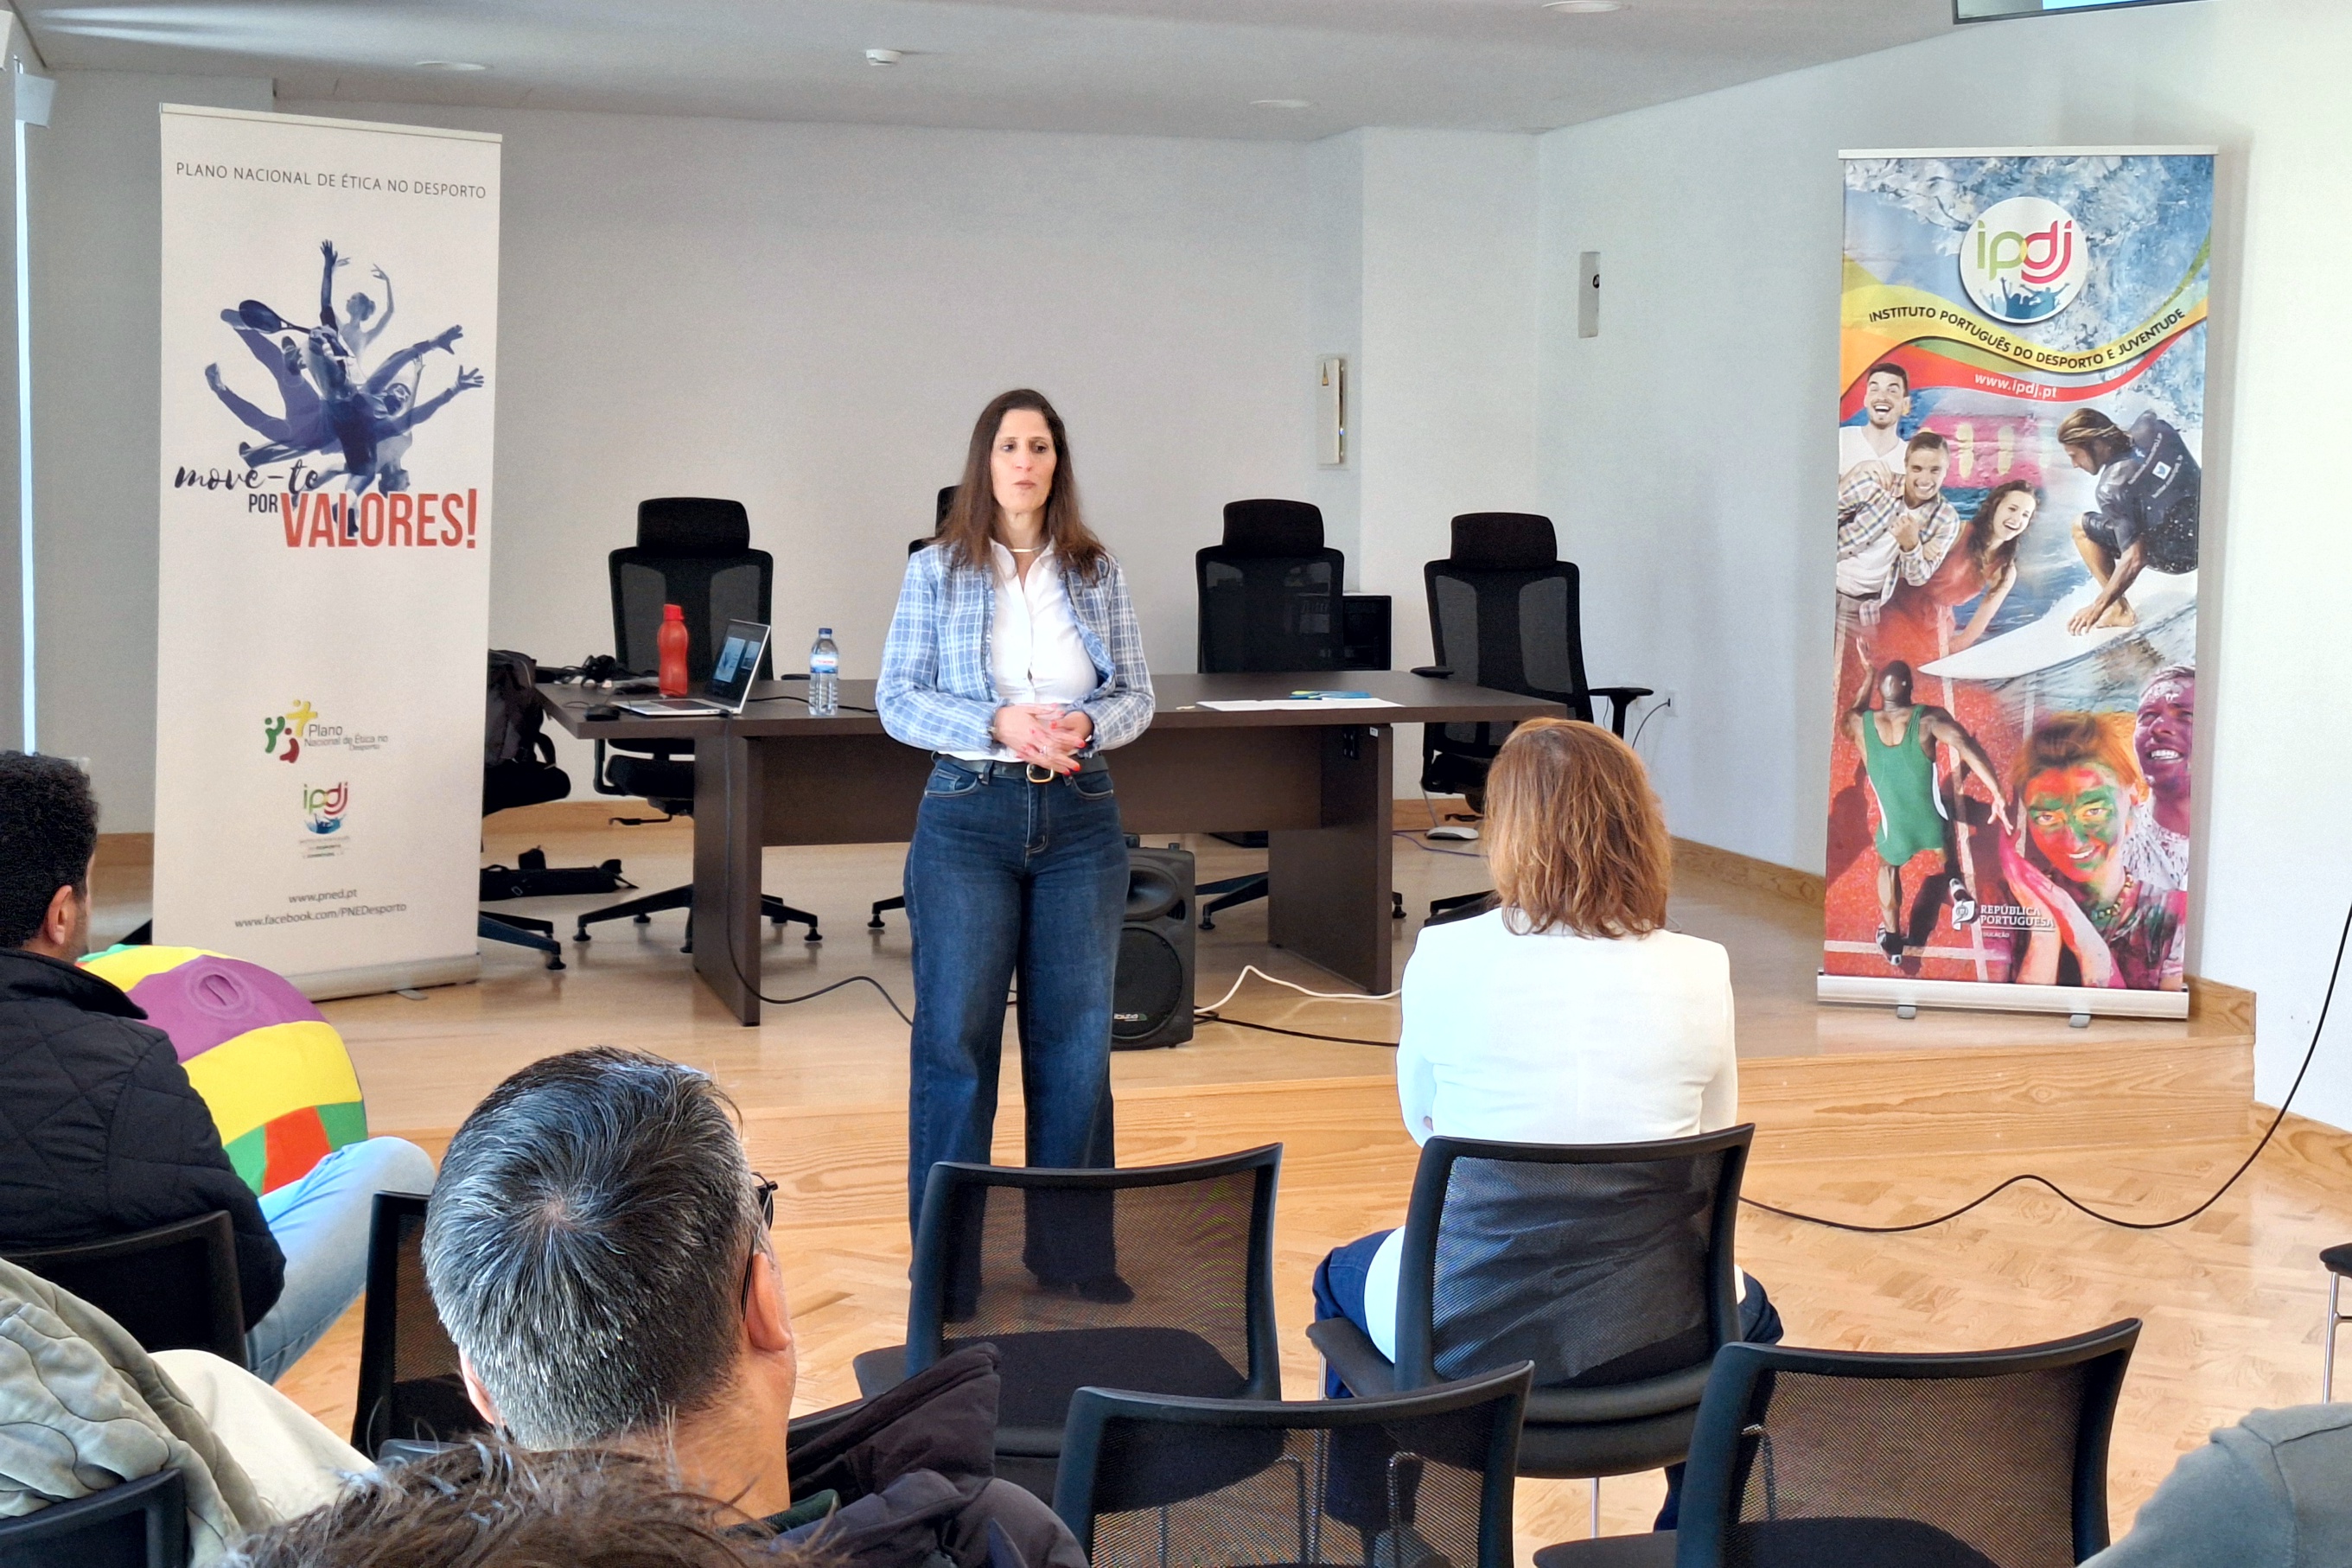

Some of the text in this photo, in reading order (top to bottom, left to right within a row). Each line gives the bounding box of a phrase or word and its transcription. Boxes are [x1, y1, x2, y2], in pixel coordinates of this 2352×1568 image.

[176, 162, 487, 199] PLANO NACIONAL DE ÉTICA NO DESPORTO
[1976, 220, 2073, 284] ipdj
[1869, 306, 2185, 369] INSTITUTO PORTUGUÊS DO DESPORTO E JUVENTUDE
[1974, 373, 2058, 399] www.ipdj.pt
[174, 458, 320, 494] move-te
[248, 488, 478, 549] POR VALORES!
[309, 723, 343, 737] Plano
[303, 781, 348, 815] ipdj
[288, 889, 357, 903] www.pned.pt
[1980, 903, 2041, 916] REPÚBLICA
[234, 902, 407, 927] www.facebook.com/PNEDesporto
[1980, 915, 2056, 927] PORTUGUESA
